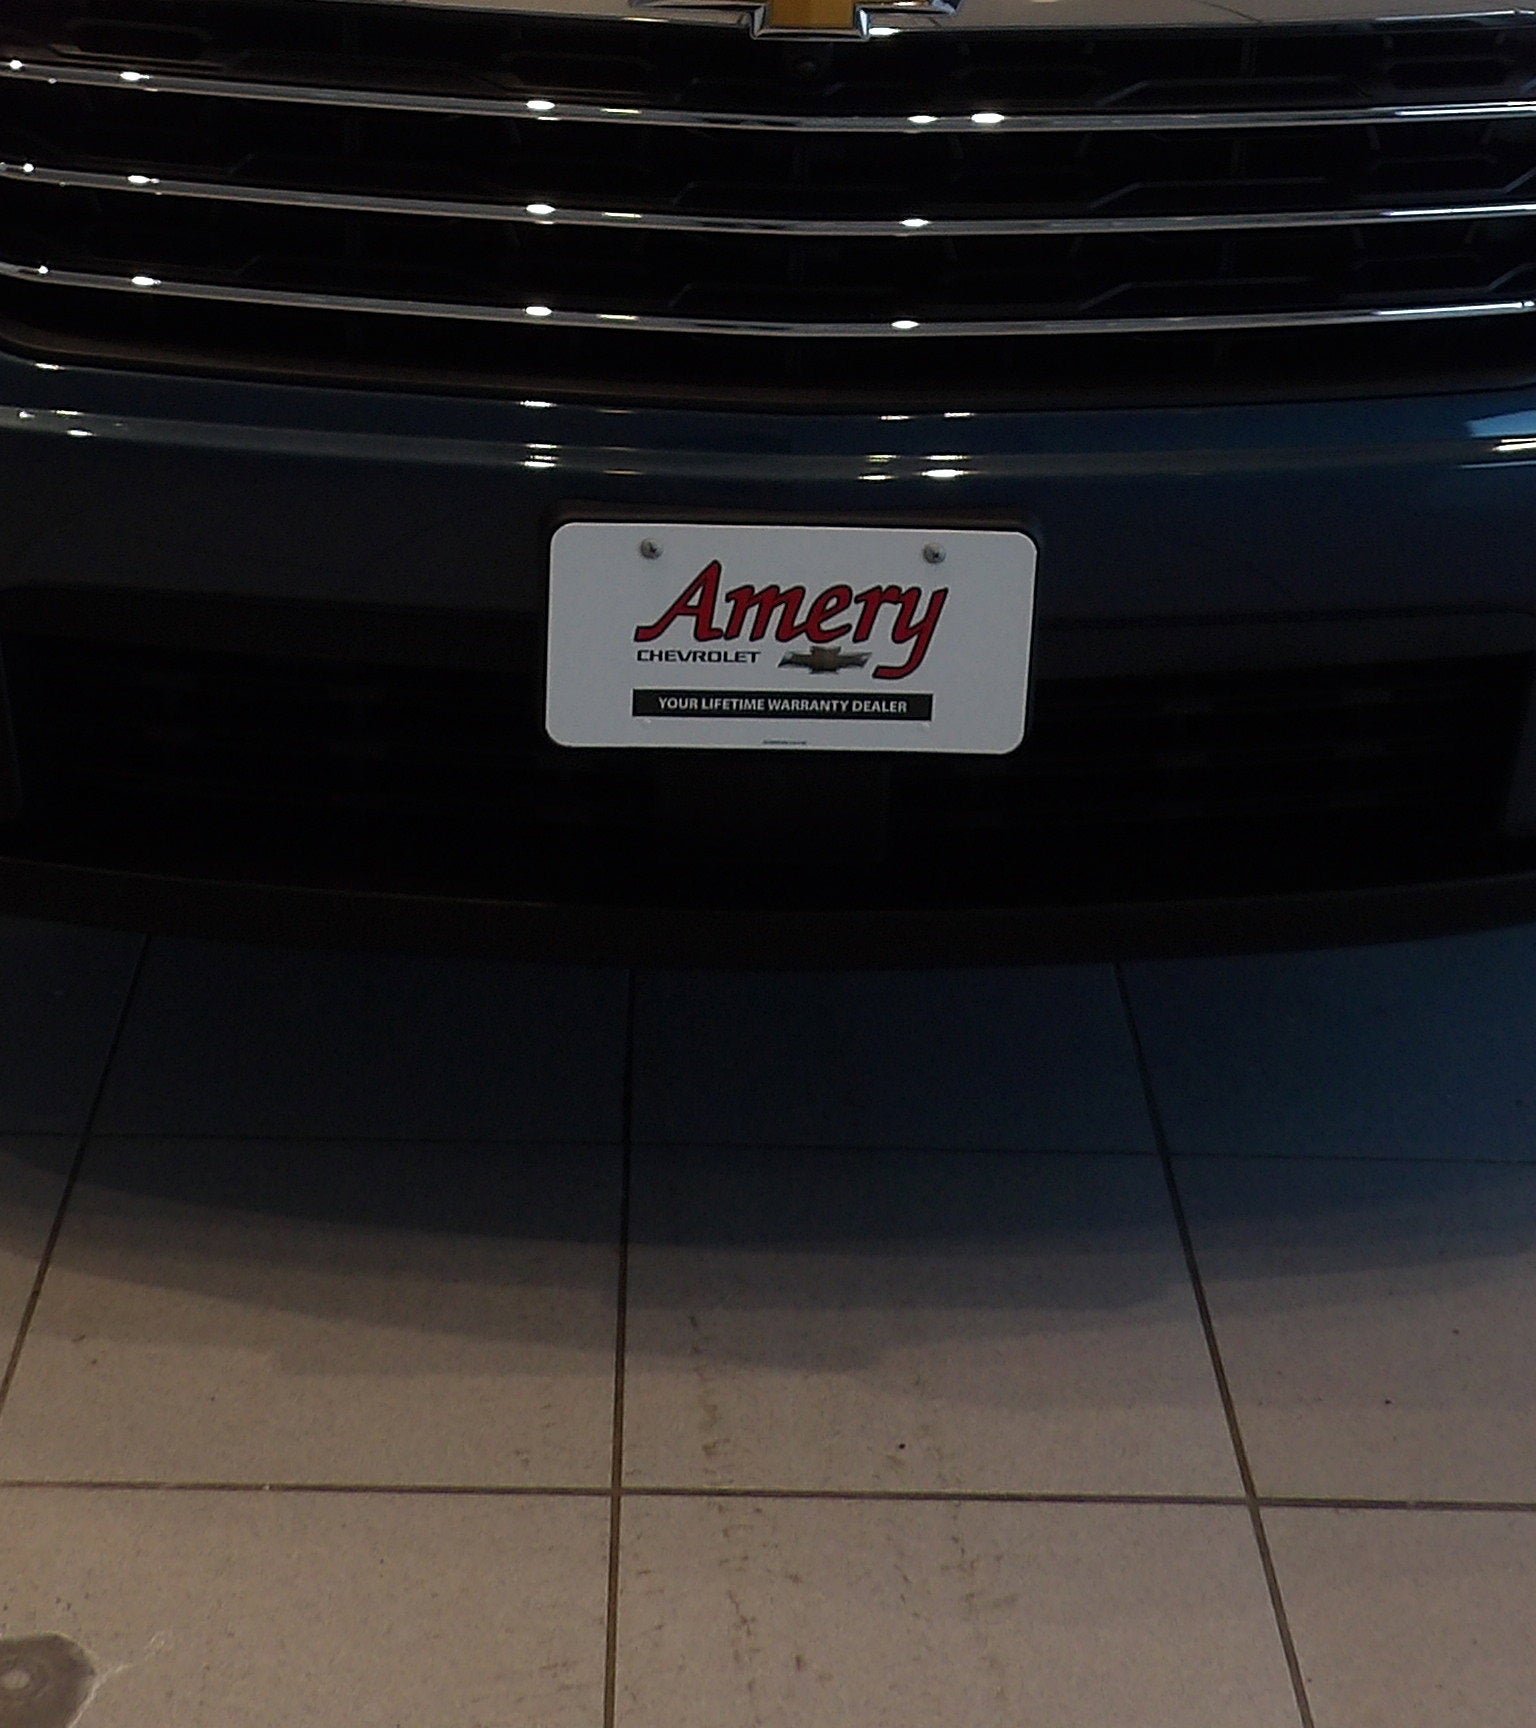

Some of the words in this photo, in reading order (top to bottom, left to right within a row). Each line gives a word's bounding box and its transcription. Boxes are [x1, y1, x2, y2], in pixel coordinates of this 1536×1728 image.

[634, 558, 949, 680] Amery
[636, 649, 761, 664] CHEVROLET
[658, 697, 699, 710] YOUR
[702, 697, 765, 711] LIFETIME
[768, 698, 850, 713] WARRANTY
[852, 699, 908, 714] DEALER
